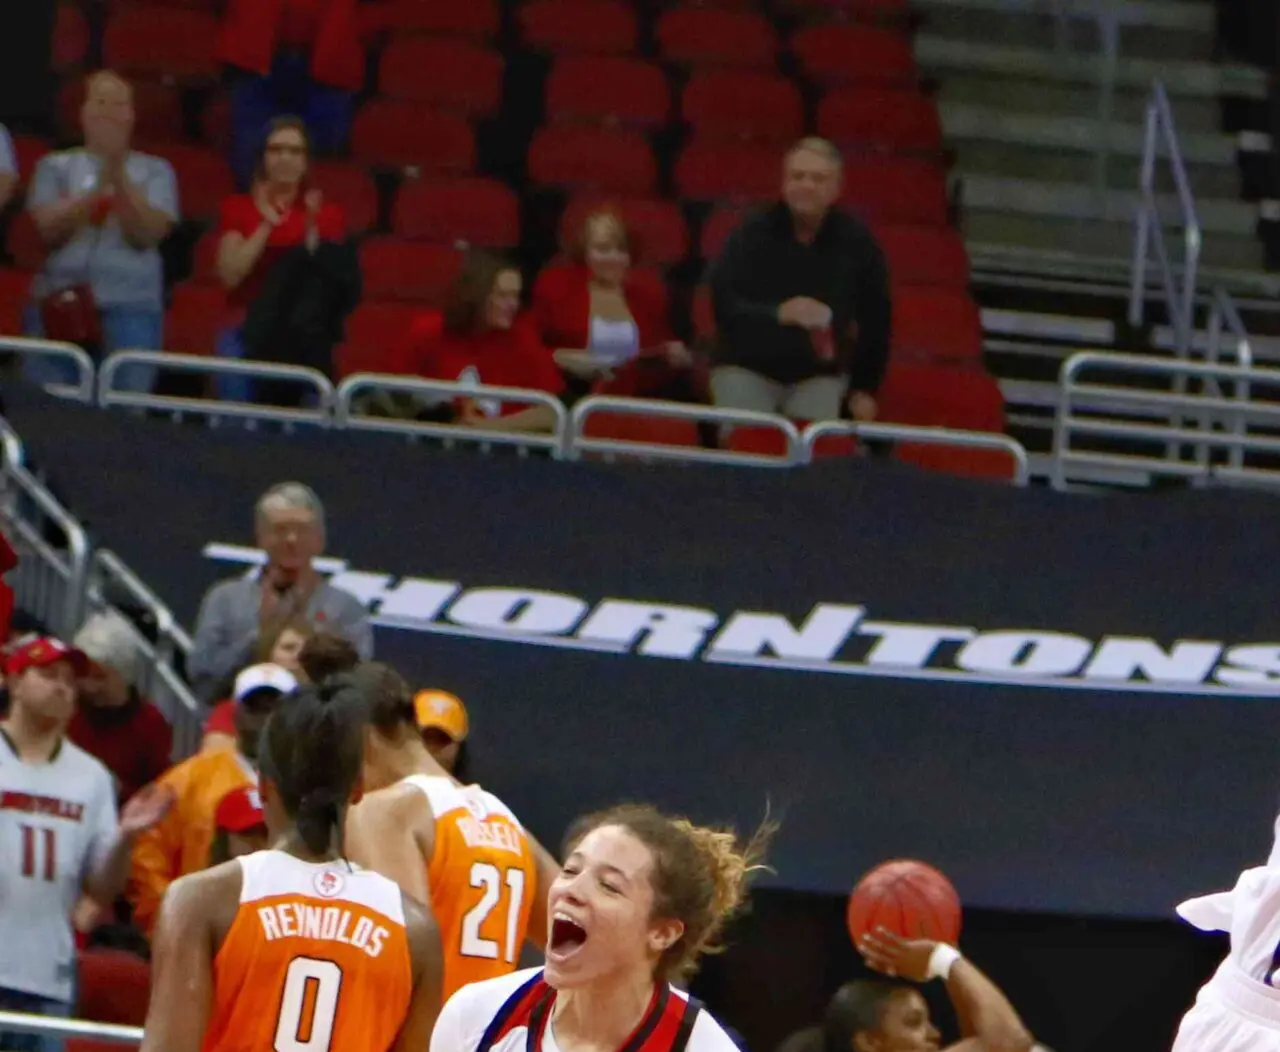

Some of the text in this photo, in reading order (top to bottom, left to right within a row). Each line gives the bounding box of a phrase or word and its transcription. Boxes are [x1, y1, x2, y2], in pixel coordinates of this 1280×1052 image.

[19, 823, 56, 881] 11
[258, 902, 390, 957] REYNOLDS
[460, 861, 524, 963] 21
